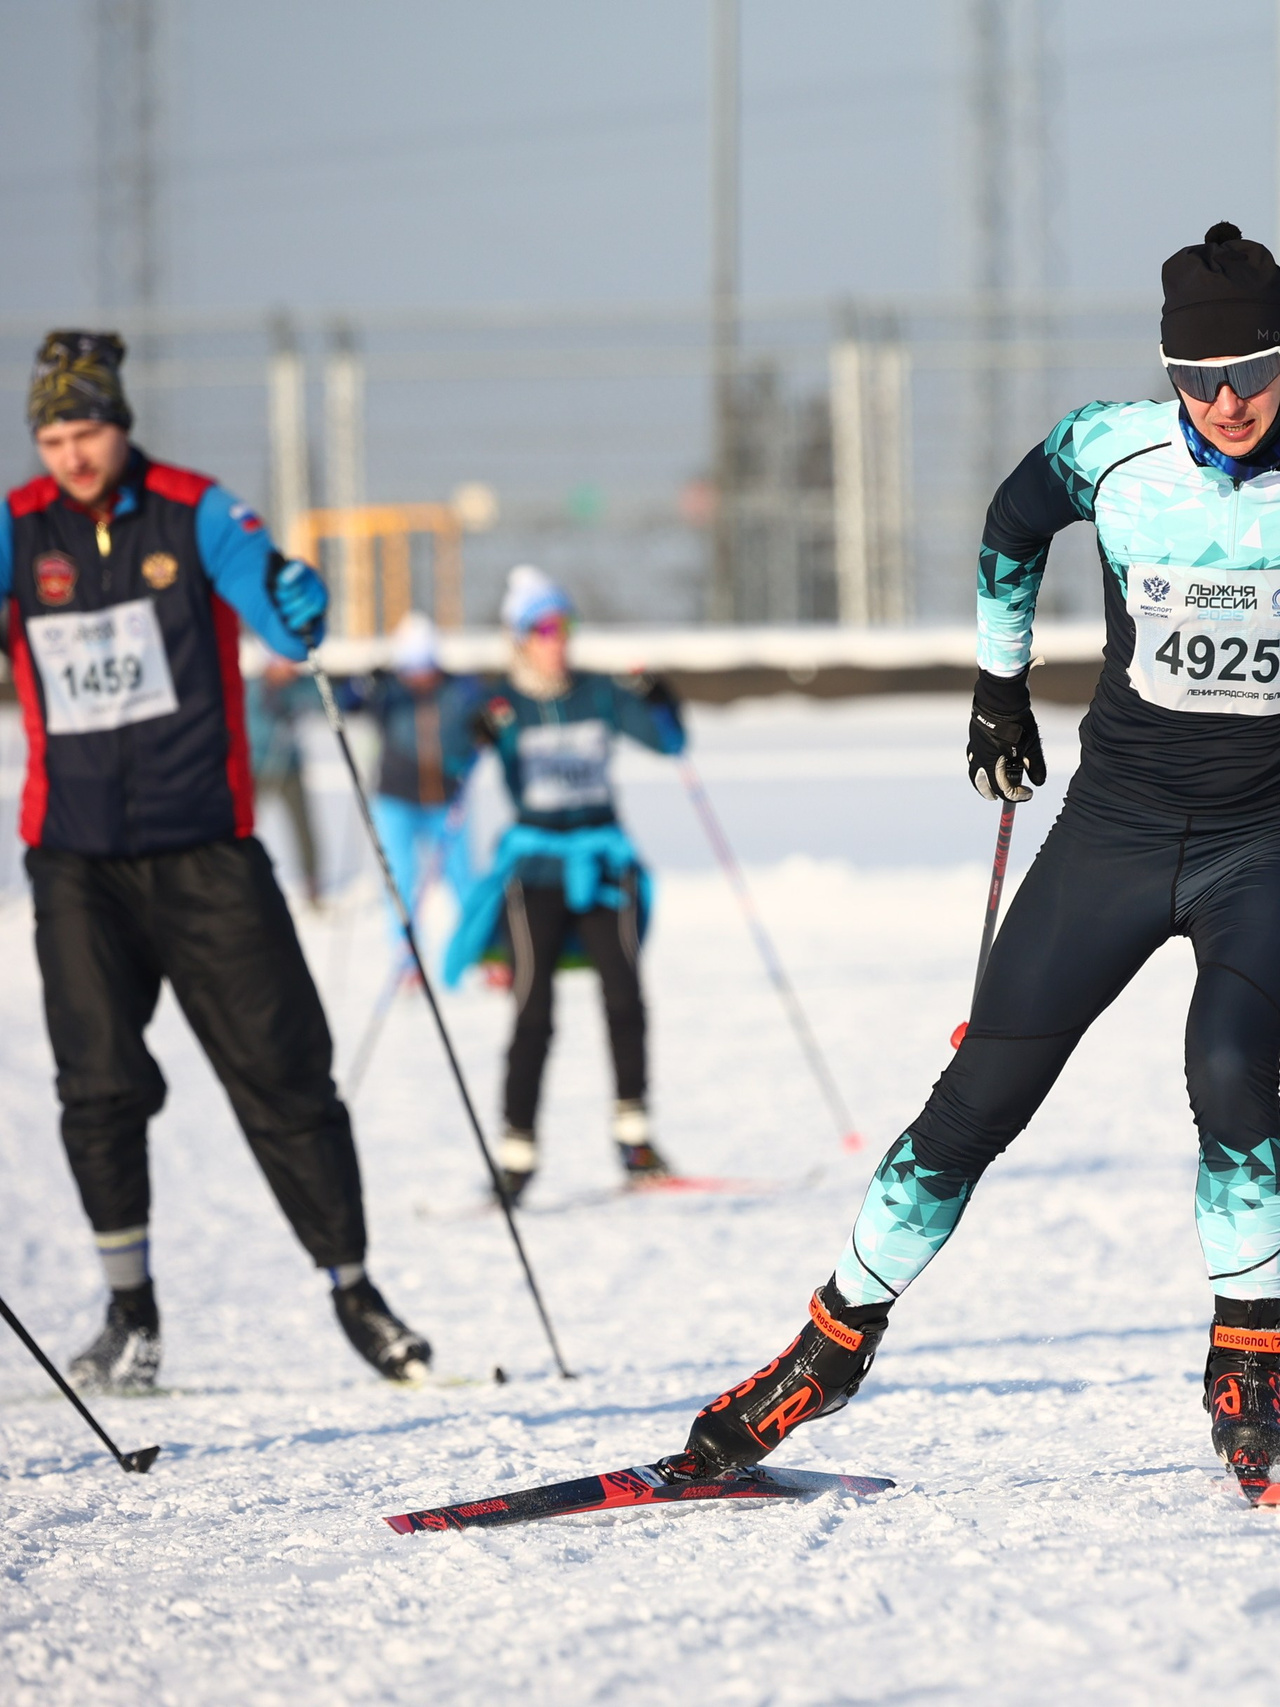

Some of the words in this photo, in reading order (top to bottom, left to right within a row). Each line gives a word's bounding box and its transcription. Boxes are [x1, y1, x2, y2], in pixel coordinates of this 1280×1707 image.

[1188, 583, 1256, 597] ЛЫЖНЯ
[1185, 596, 1258, 610] РОССИИ
[1197, 610, 1244, 621] 2025
[1155, 631, 1280, 683] 4925
[63, 654, 143, 699] 1459
[1187, 688, 1260, 700] ЛЕНИНГРАДСКАЯ
[816, 1312, 858, 1348] ROSSIGNOL
[1216, 1332, 1269, 1348] ROSSIGNOL
